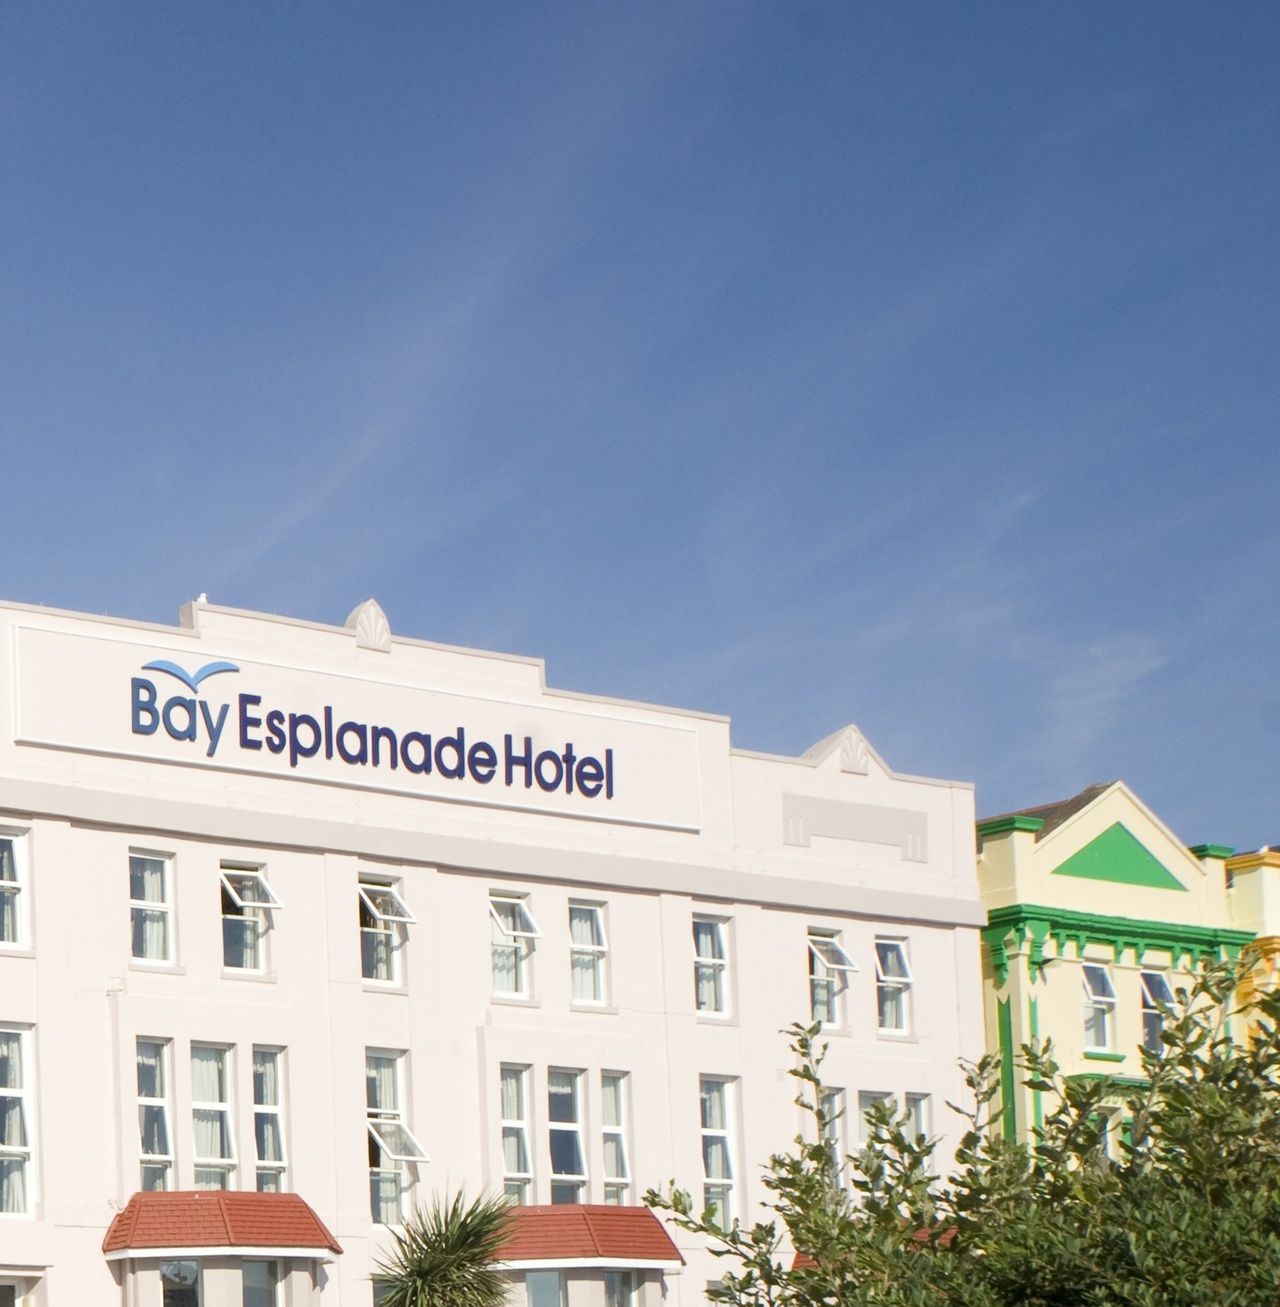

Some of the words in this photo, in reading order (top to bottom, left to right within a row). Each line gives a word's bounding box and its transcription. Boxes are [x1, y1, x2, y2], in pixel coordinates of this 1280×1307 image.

[131, 677, 230, 757] Bay
[238, 693, 498, 784] Esplanade
[504, 733, 614, 800] Hotel
